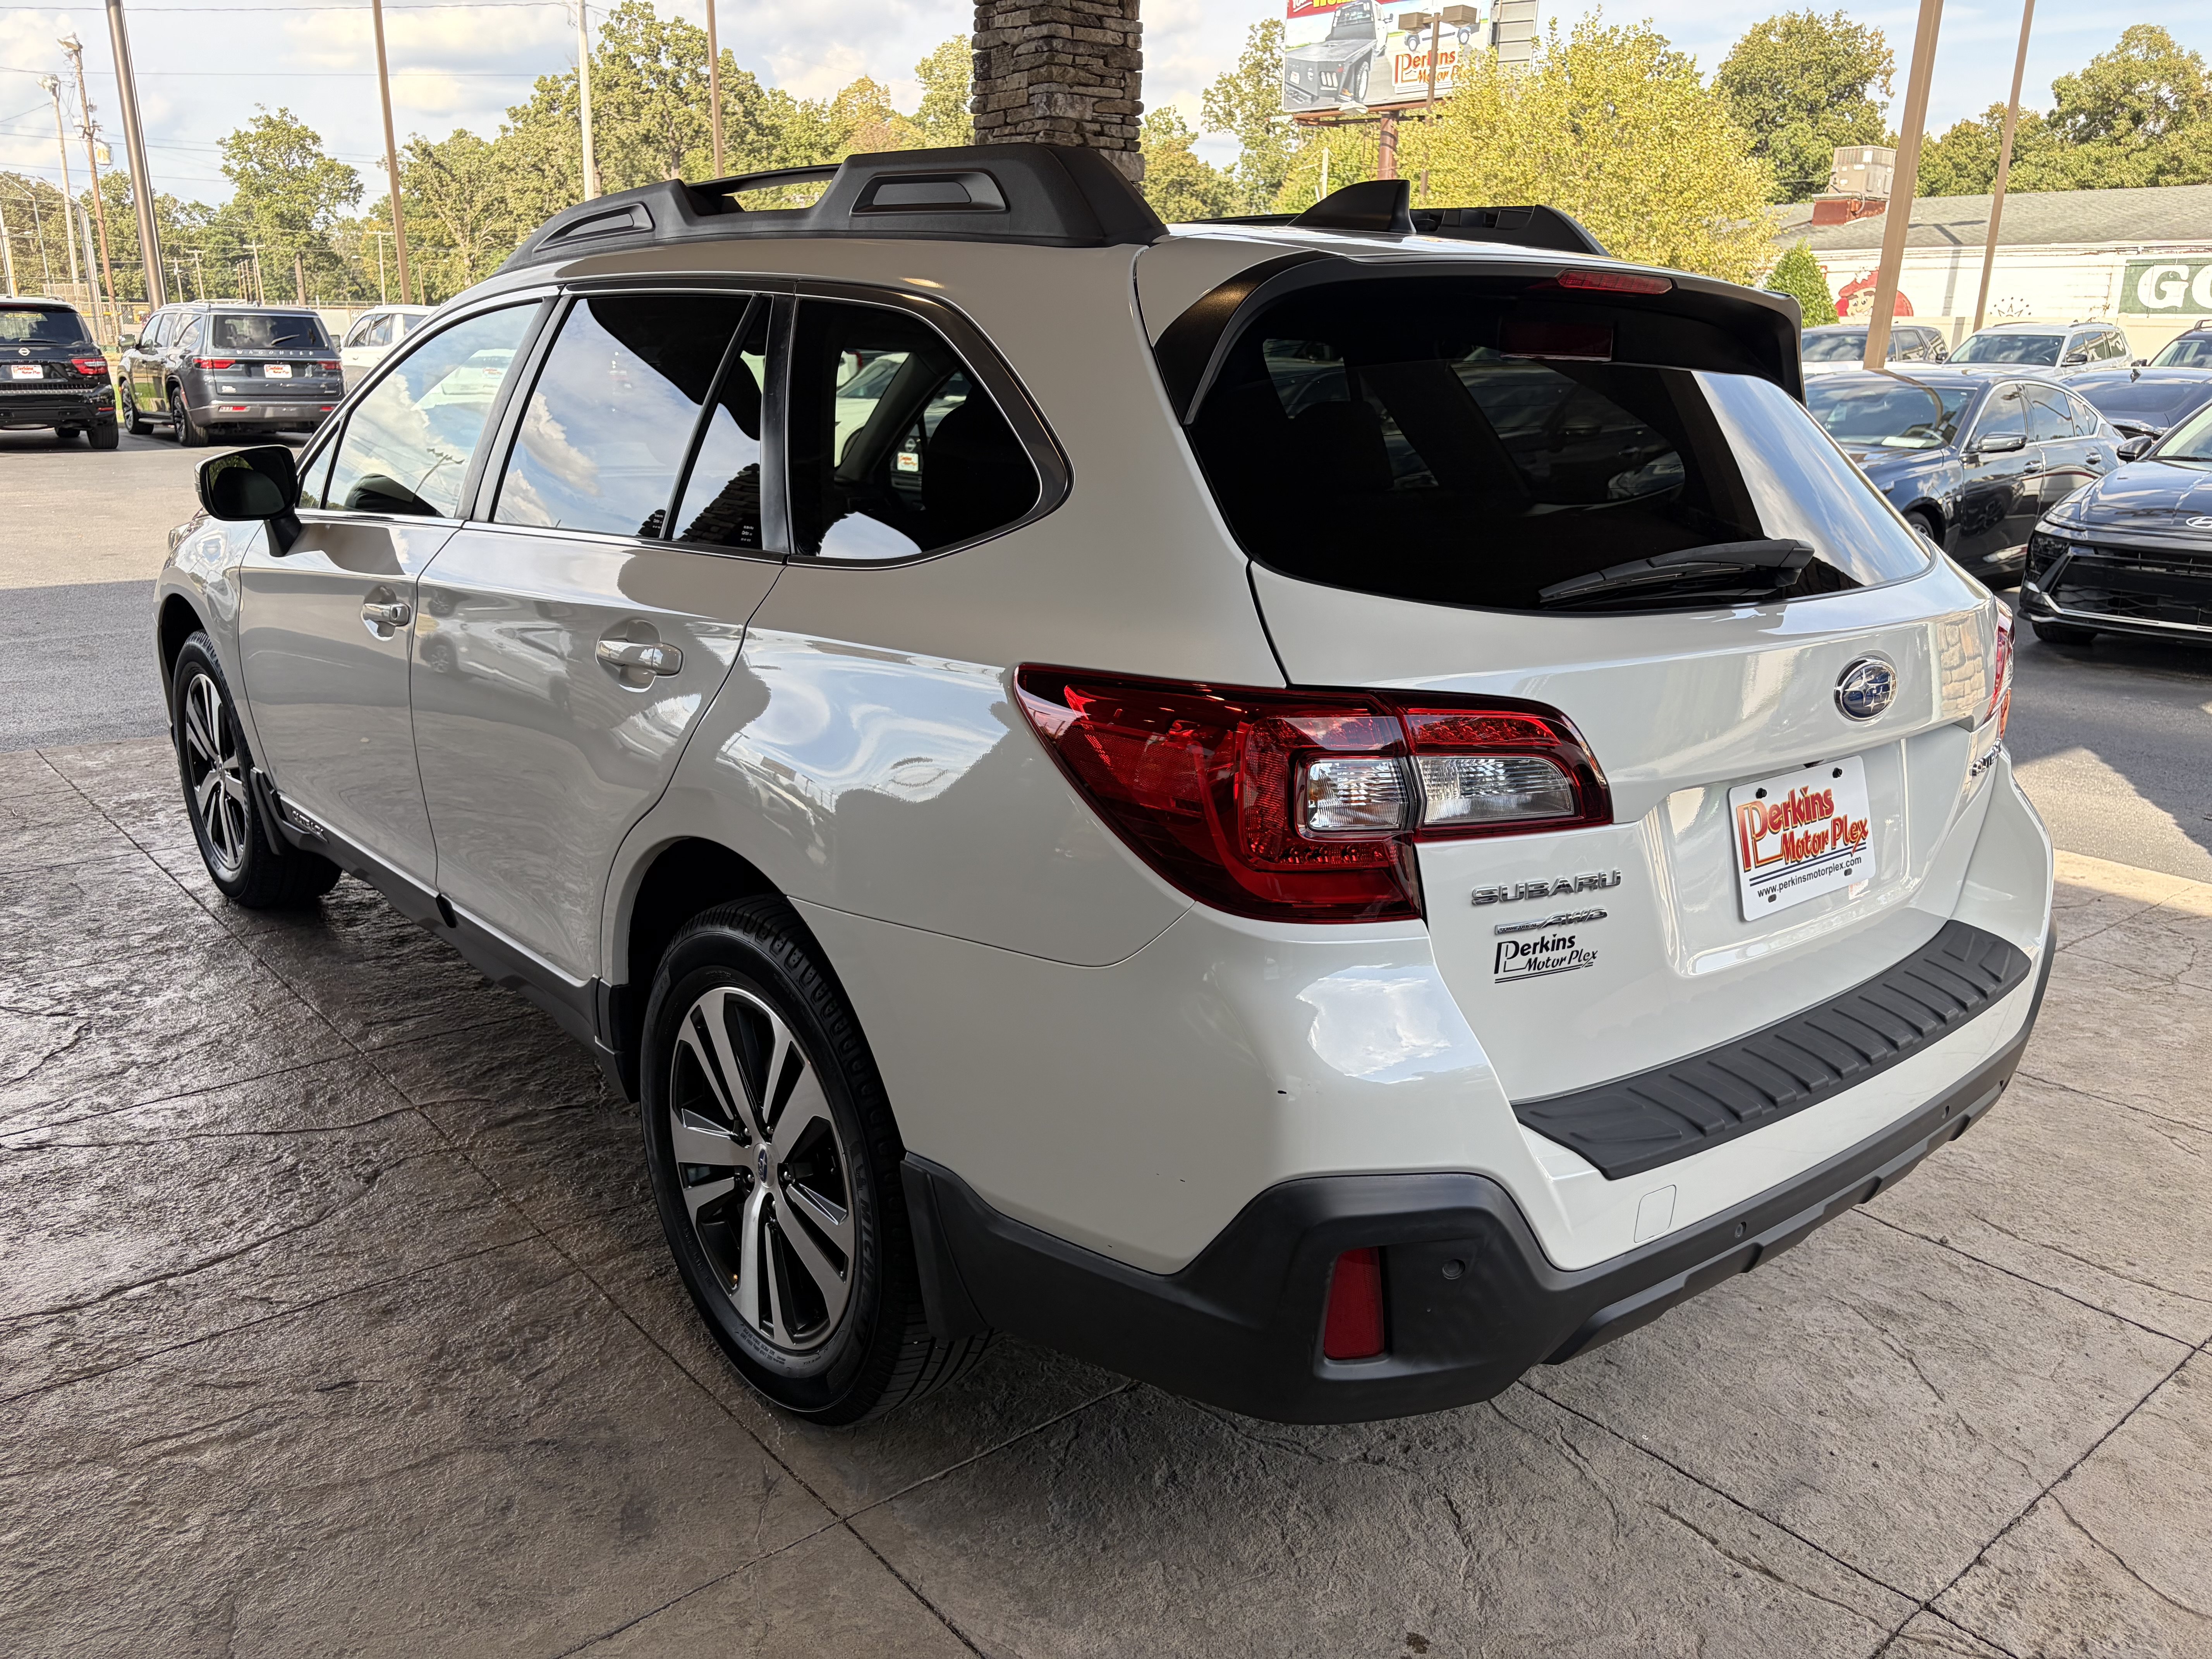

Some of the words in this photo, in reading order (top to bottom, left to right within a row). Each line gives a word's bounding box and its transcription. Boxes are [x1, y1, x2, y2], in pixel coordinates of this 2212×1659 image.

[1395, 51, 1455, 84] Perns
[1418, 69, 1449, 84] Moor
[1736, 786, 1835, 873] Perkins
[1781, 828, 1829, 865] Motor
[1831, 814, 1869, 857] Plex
[1472, 870, 1622, 905] SUBARU
[1757, 855, 1862, 898] www.perkinsmotorplex.com
[1498, 923, 1539, 933] SYMMETRICAL
[1537, 907, 1608, 930] AWD
[1494, 934, 1576, 974] Perkins
[1525, 955, 1567, 972] Motor
[1567, 948, 1598, 968] Plex
